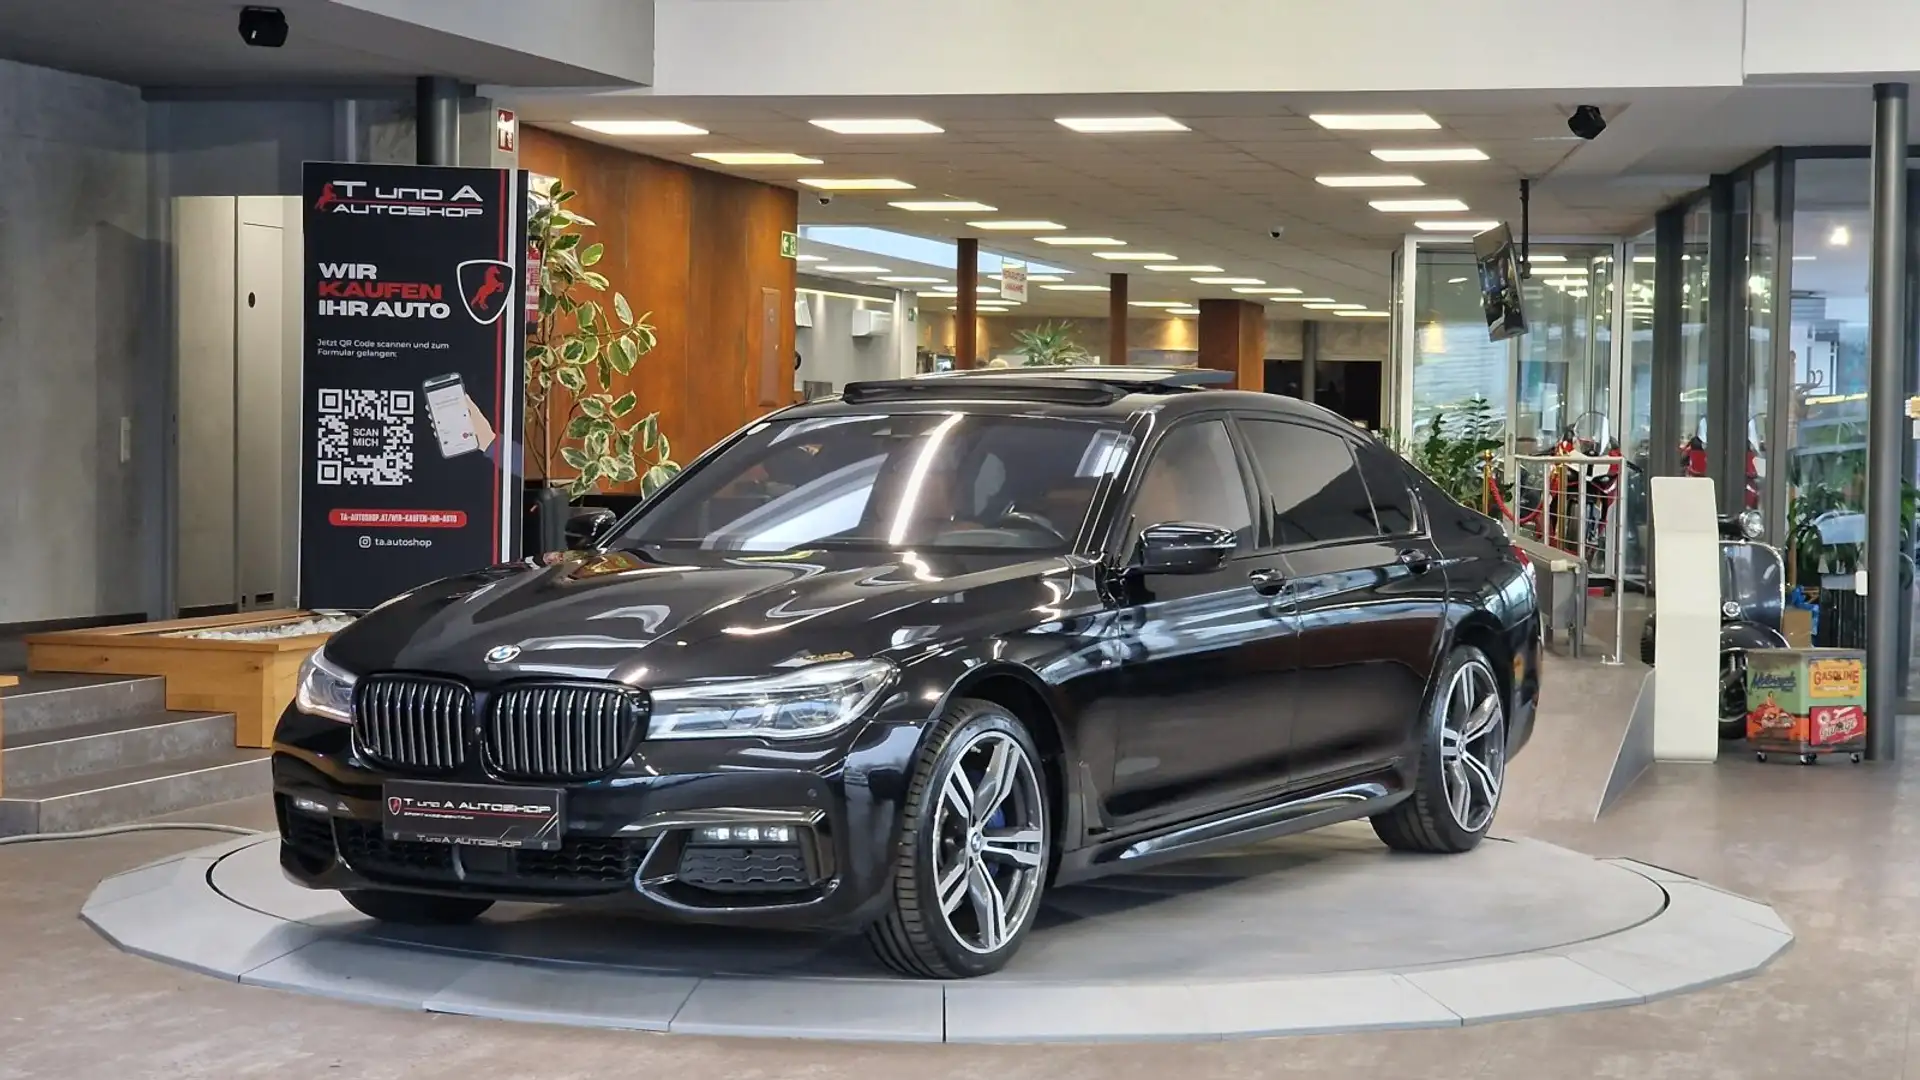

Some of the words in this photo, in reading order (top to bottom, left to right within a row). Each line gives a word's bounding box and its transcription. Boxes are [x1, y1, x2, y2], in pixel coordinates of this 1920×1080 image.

[332, 180, 367, 198] T
[450, 184, 484, 202] A
[333, 204, 484, 217] AUTOSHOP
[318, 262, 377, 280] WIR
[318, 281, 442, 299] KAUFEN
[318, 300, 370, 317] IHR
[372, 302, 451, 319] AUTO
[317, 338, 338, 347] Jetzt
[338, 339, 352, 348] QR
[353, 339, 375, 348] Code
[413, 340, 430, 349] und
[317, 348, 355, 356] Formular
[352, 427, 380, 437] SCAN
[352, 437, 380, 447] MICH
[374, 537, 433, 549] ta.autoshop
[458, 801, 551, 812] AUTOSHOP
[454, 837, 522, 847] AUTOSHOP
